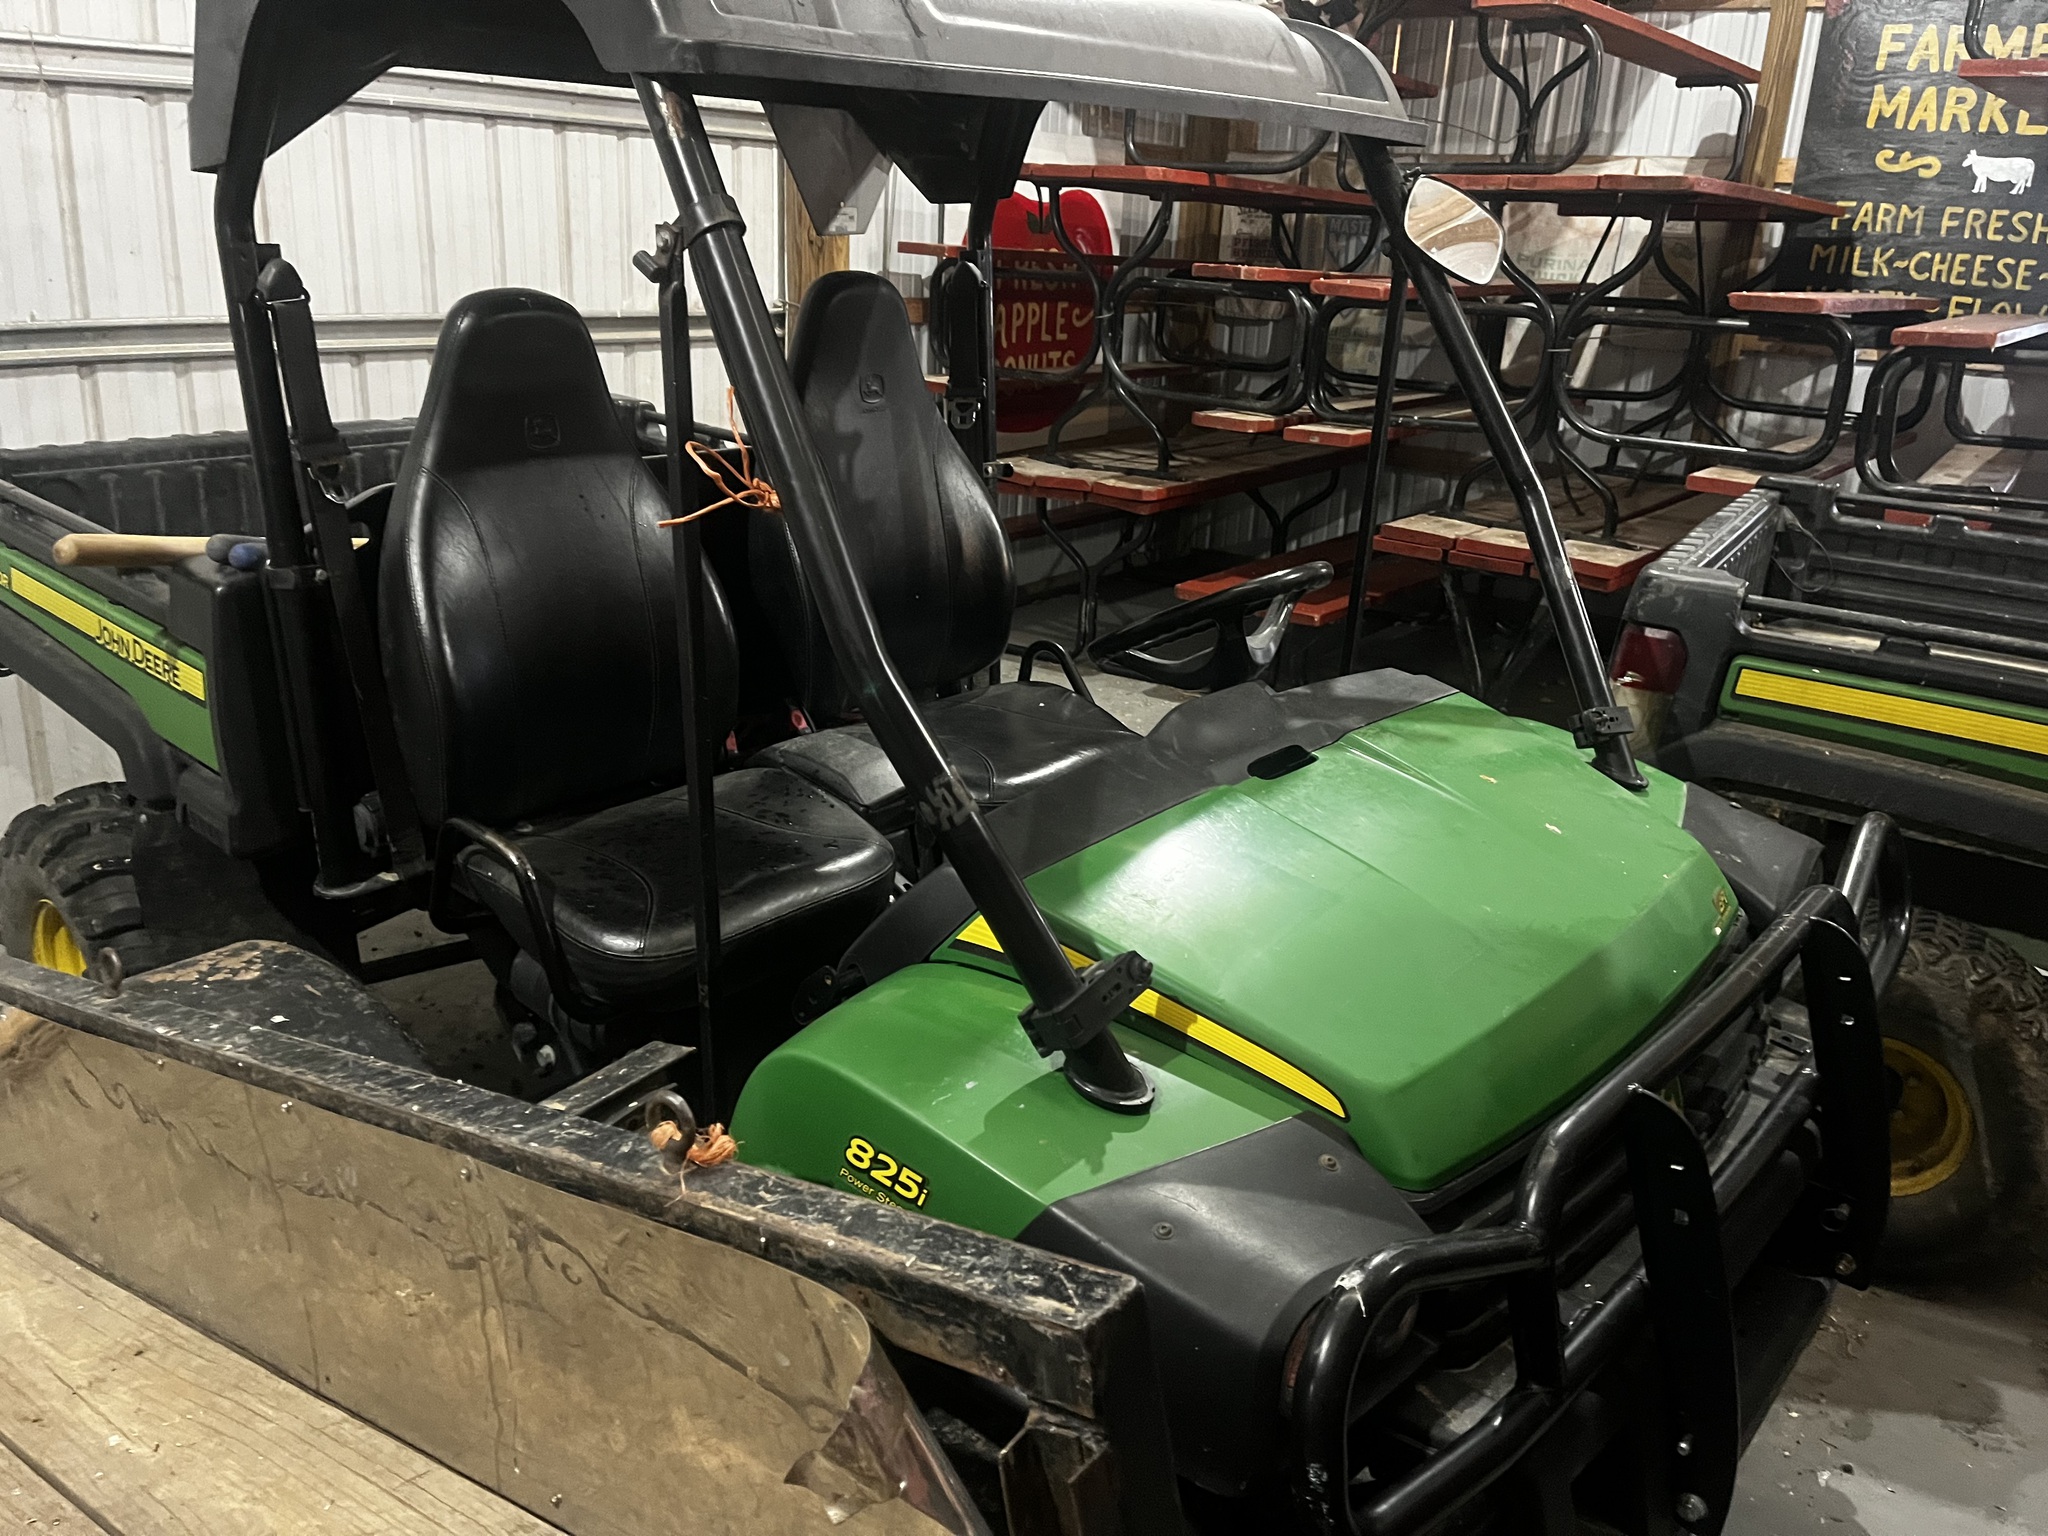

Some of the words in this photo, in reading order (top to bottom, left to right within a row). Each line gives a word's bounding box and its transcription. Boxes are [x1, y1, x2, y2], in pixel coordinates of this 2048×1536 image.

[995, 301, 1069, 348] APPLE
[95, 618, 132, 660] JOHN
[131, 638, 182, 689] DEERE
[839, 1167, 875, 1195] Power
[876, 1191, 902, 1210] Ste
[845, 1137, 928, 1207] 825i
